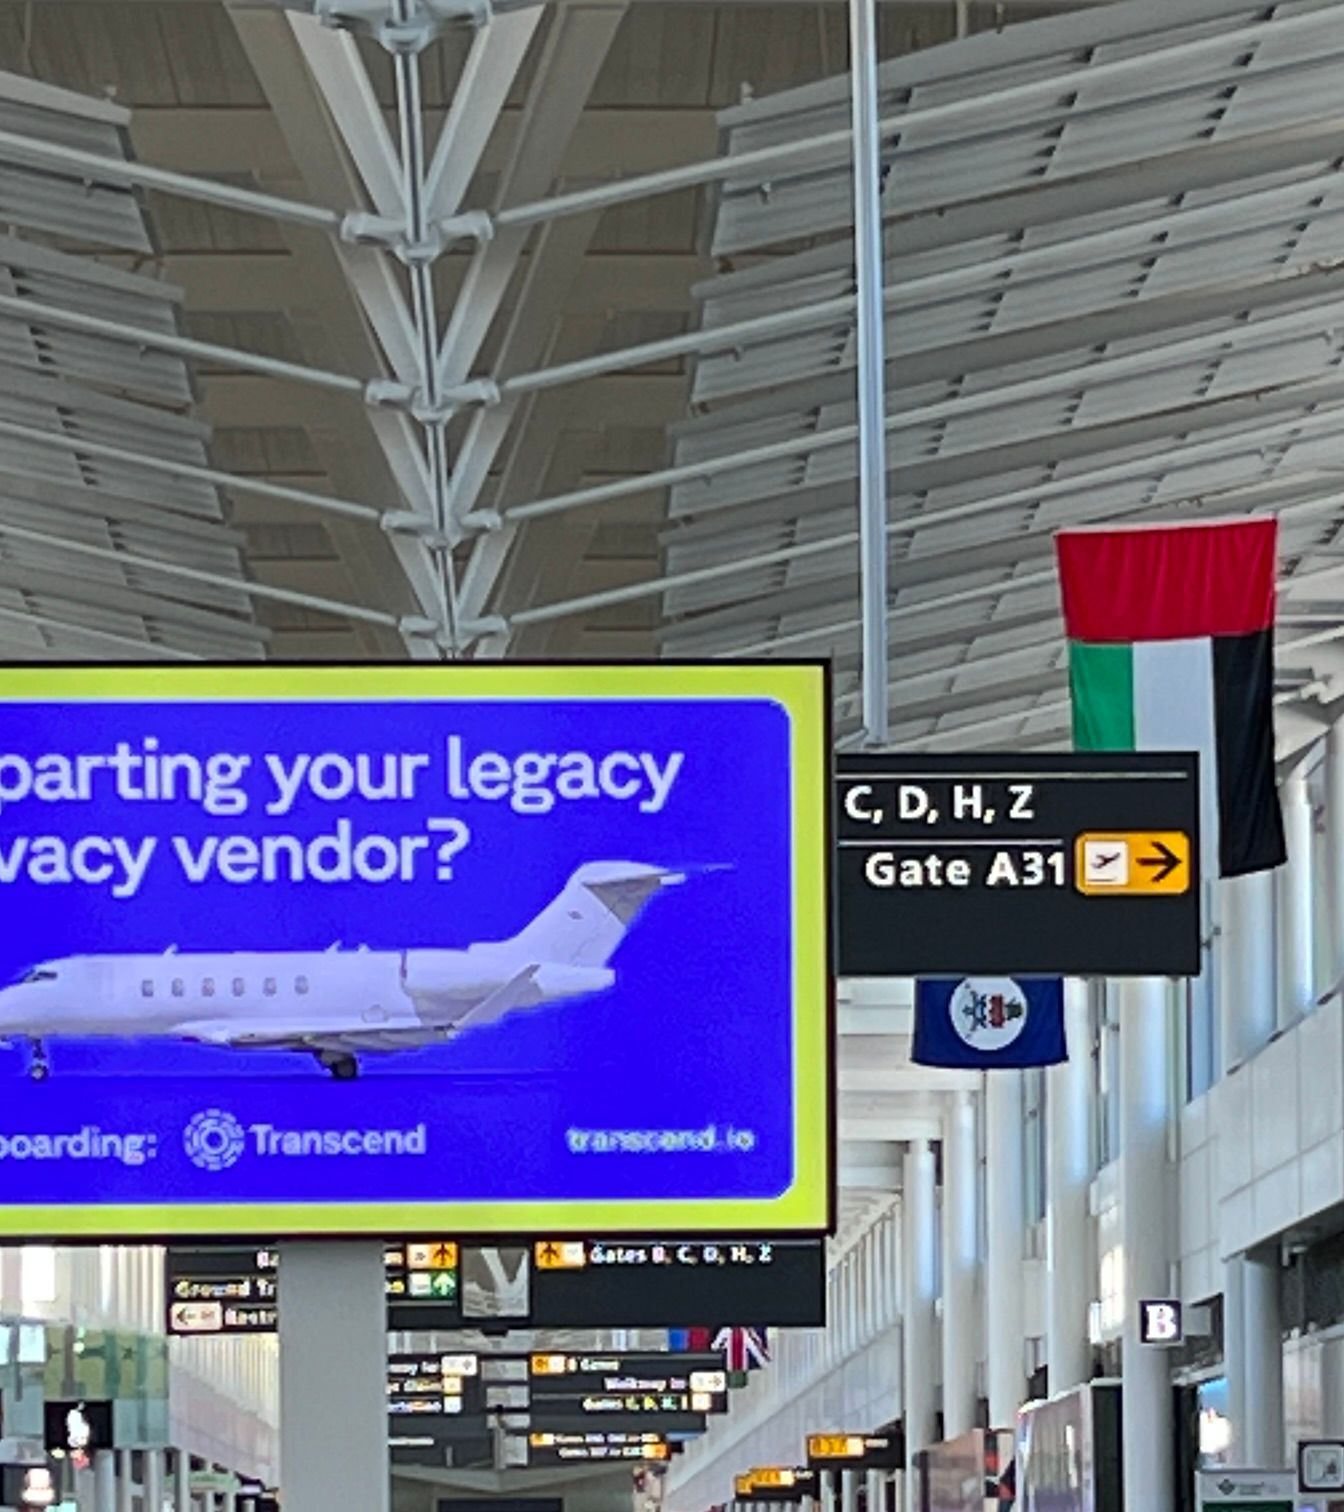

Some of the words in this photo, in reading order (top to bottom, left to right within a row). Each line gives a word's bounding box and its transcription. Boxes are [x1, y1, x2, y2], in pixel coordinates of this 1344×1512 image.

[264, 754, 429, 809] your
[447, 735, 685, 813] legacy
[843, 784, 885, 824] C,
[898, 784, 939, 824] D,
[952, 784, 996, 824] H,
[1009, 784, 1035, 819] Z
[171, 816, 471, 885] vendor?
[864, 851, 971, 887] Gate
[986, 851, 1066, 886] A31
[248, 1123, 427, 1155] Transcend
[565, 1122, 756, 1154] transcend.io
[590, 1245, 647, 1264] Gates
[1145, 1303, 1177, 1340] B
